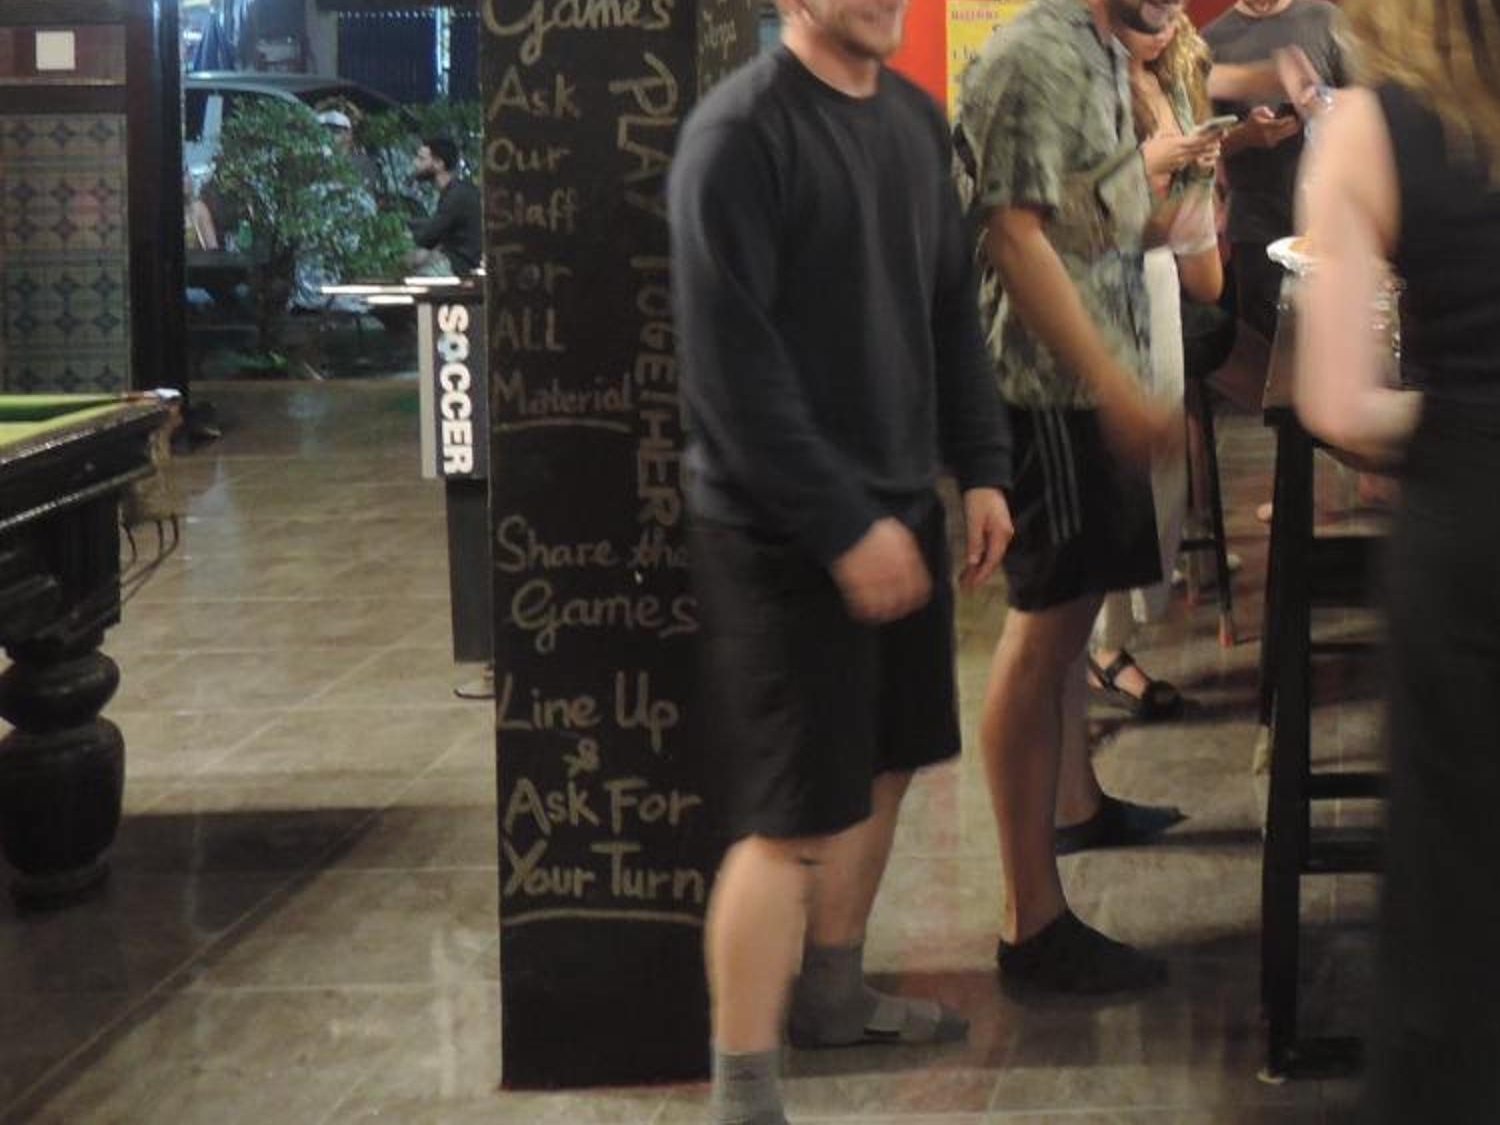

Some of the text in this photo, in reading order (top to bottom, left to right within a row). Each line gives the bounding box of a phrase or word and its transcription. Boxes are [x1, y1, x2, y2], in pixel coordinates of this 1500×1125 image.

[488, 64, 581, 121] Ask
[486, 137, 571, 172] Our
[492, 243, 573, 292] For
[438, 304, 474, 475] SOCCER
[492, 369, 634, 415] Material
[496, 515, 616, 573] Share
[509, 580, 698, 653] Games
[496, 670, 680, 754] Line Up
[502, 779, 702, 835] Ask For
[501, 838, 706, 904] Your Turn
